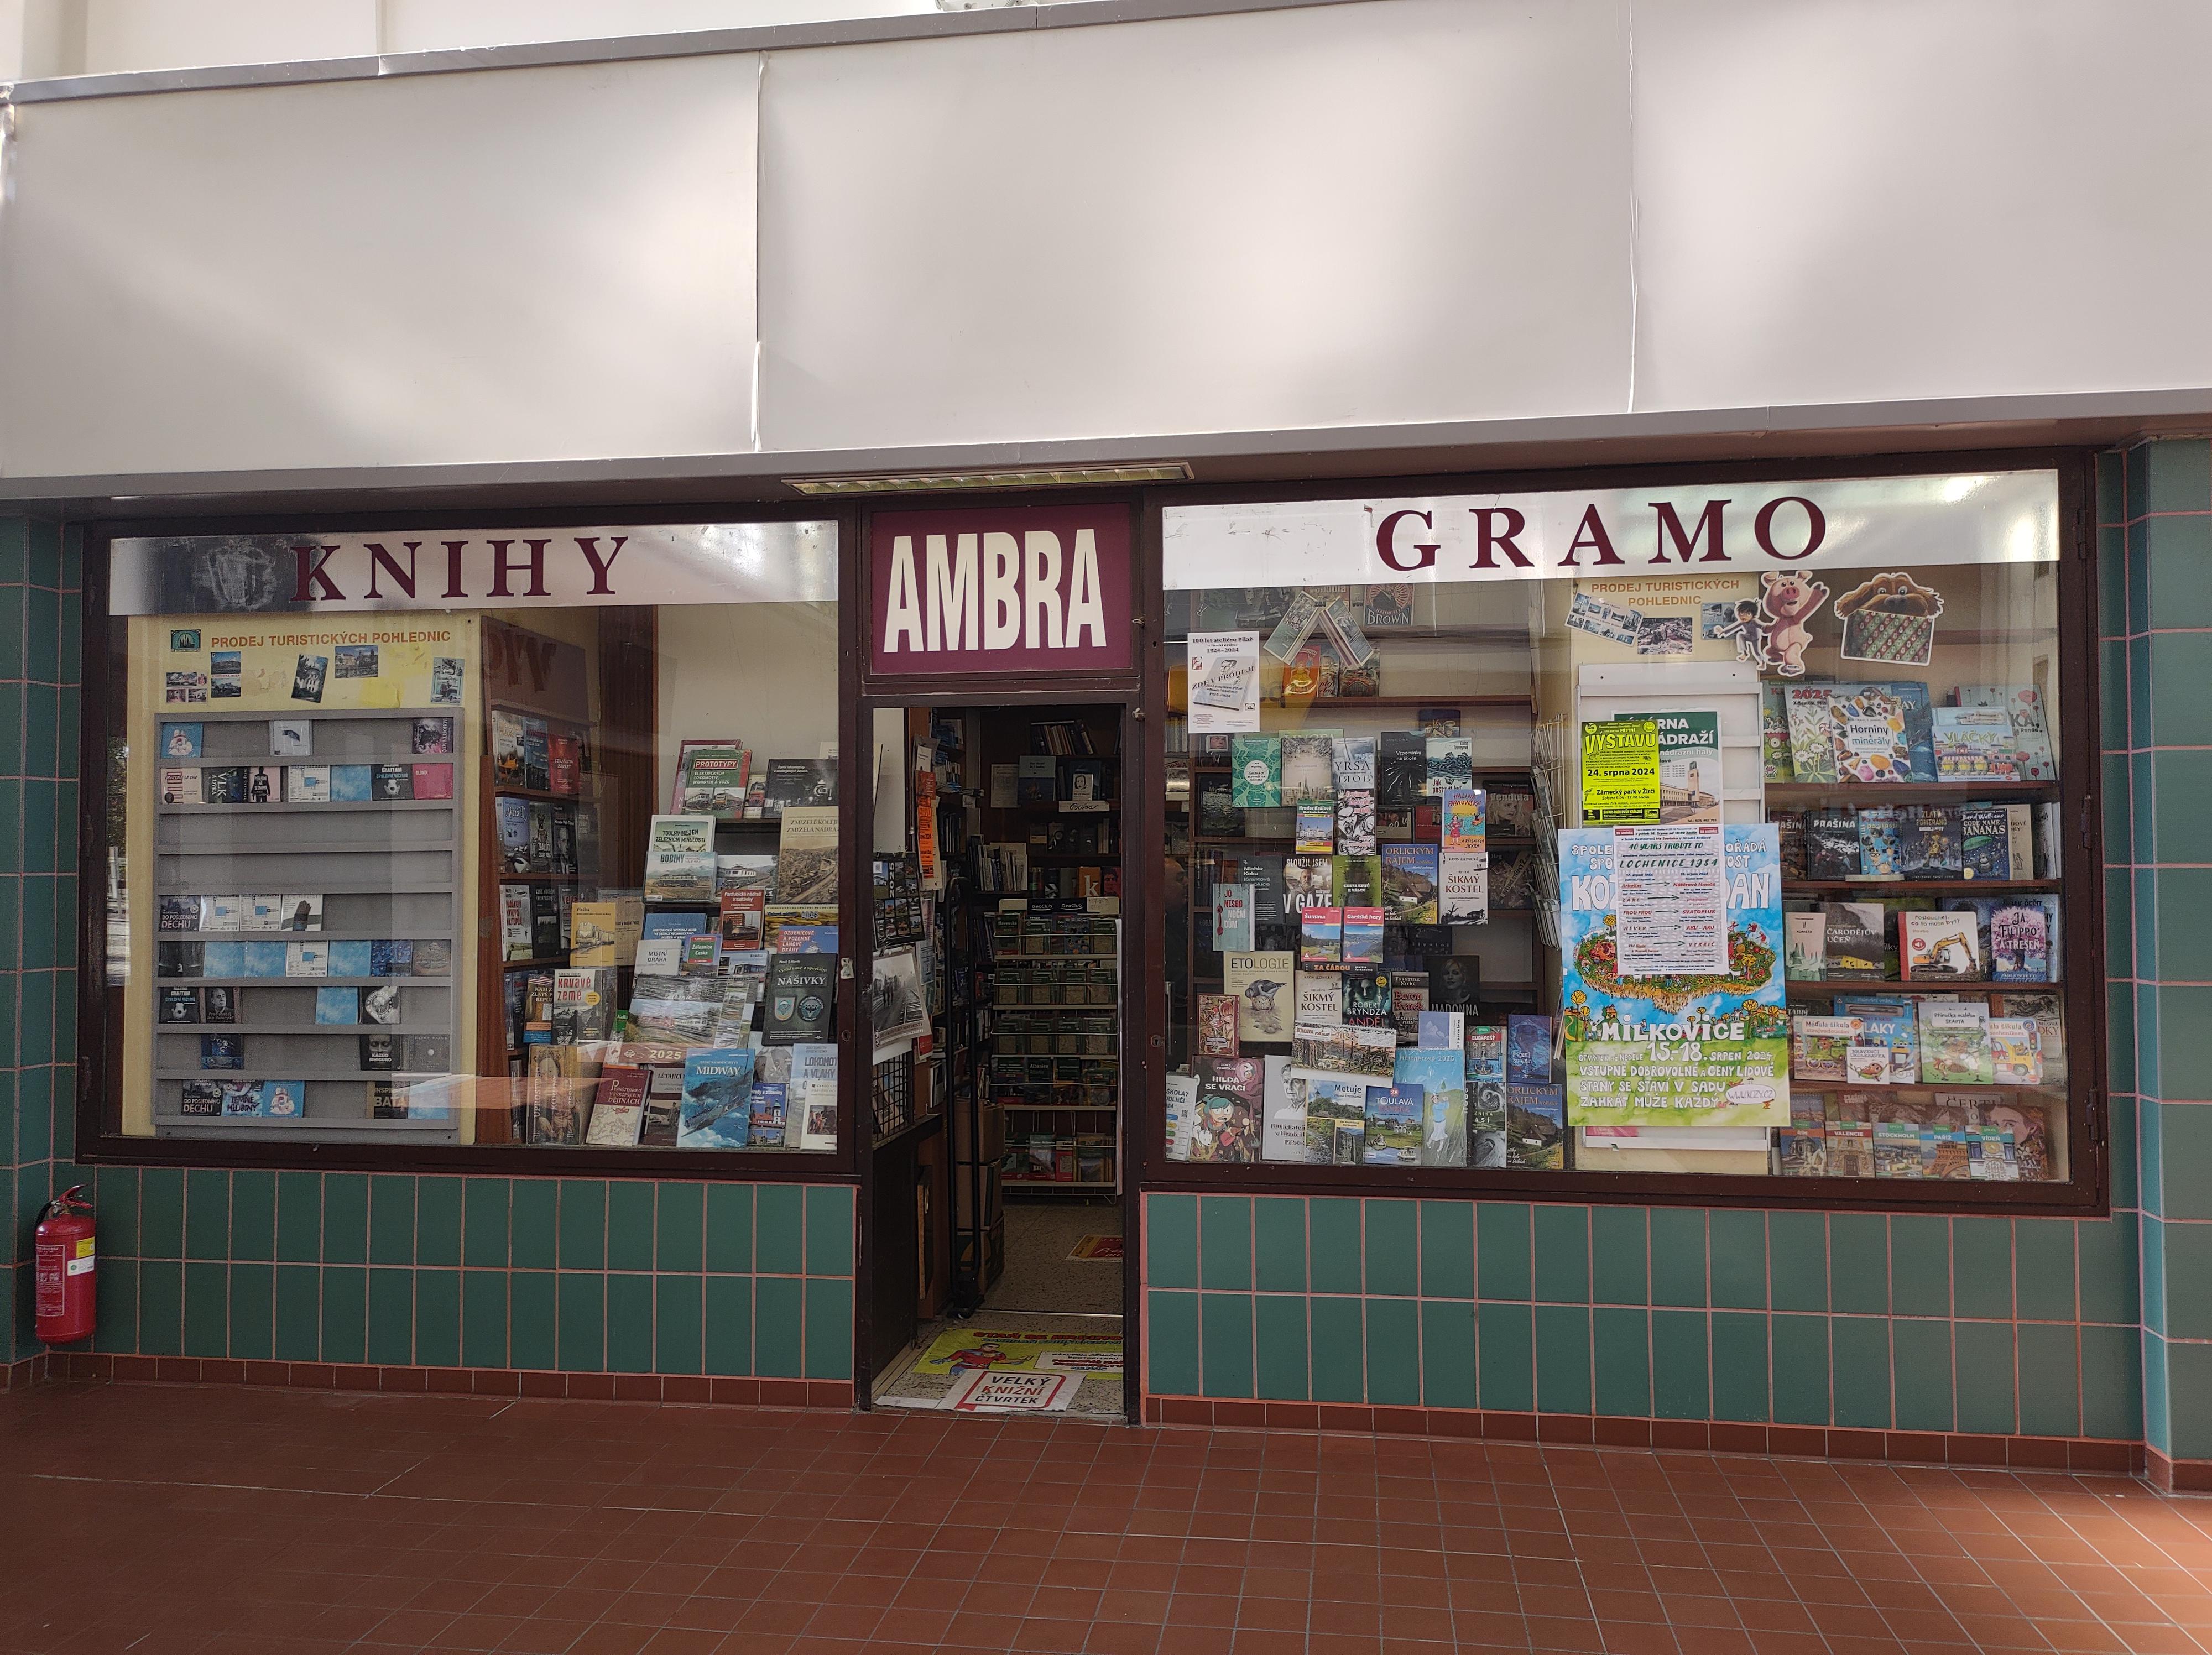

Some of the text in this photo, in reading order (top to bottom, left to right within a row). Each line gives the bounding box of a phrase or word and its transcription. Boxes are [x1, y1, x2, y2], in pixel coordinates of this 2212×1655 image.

[1376, 496, 1826, 572] GRAMO
[290, 536, 629, 602] KNIHY
[884, 529, 1107, 652] AMBRA
[1592, 579, 1739, 593] PRODEJ TURISTICKÝCH
[1629, 596, 1701, 606] POHLEDNIC
[1367, 608, 1409, 625] BROWN
[211, 631, 450, 648] PRODEJ TURISTICKÝCH POHLEDNIC
[1850, 725, 1888, 735] Horniny
[1585, 731, 1655, 755] VÝSTAVU
[1658, 730, 1715, 745] ÁDRAŽÍ
[696, 760, 737, 768] PROTOTYPY
[1619, 859, 1686, 868] LOCHENICE
[1448, 874, 1480, 884] ŠIKMÝ
[1445, 885, 1483, 894] KOSTEL
[1231, 958, 1289, 969] ETOLOGIE
[777, 975, 826, 985] NÁŠIVKY
[1303, 991, 1334, 1002] ŠIKMÝ
[1301, 1003, 1338, 1011] KOSTEL
[650, 1050, 682, 1060] 2025
[696, 1066, 741, 1076] MIDWAY
[1579, 1062, 1627, 1077] VSTUPNÉ
[1631, 1062, 1699, 1077] DOBROVOLNÉ
[1736, 1062, 1774, 1077] LIDOVÉ
[1334, 1084, 1362, 1094] Metuje
[1580, 1080, 1615, 1092] STANY
[1619, 1080, 1632, 1092] SE
[1674, 1081, 1684, 1092] V
[1691, 1080, 1726, 1093] SADU
[1375, 1097, 1413, 1106] TOULAVÁ
[1580, 1092, 1629, 1108] ZAHRÁT
[1674, 1092, 1719, 1108] KAŽDÝ
[992, 1376, 1052, 1386] VELKÝ
[982, 1385, 1046, 1396] KNIŽNÍ
[975, 1393, 1039, 1405] ČTVRTEK
